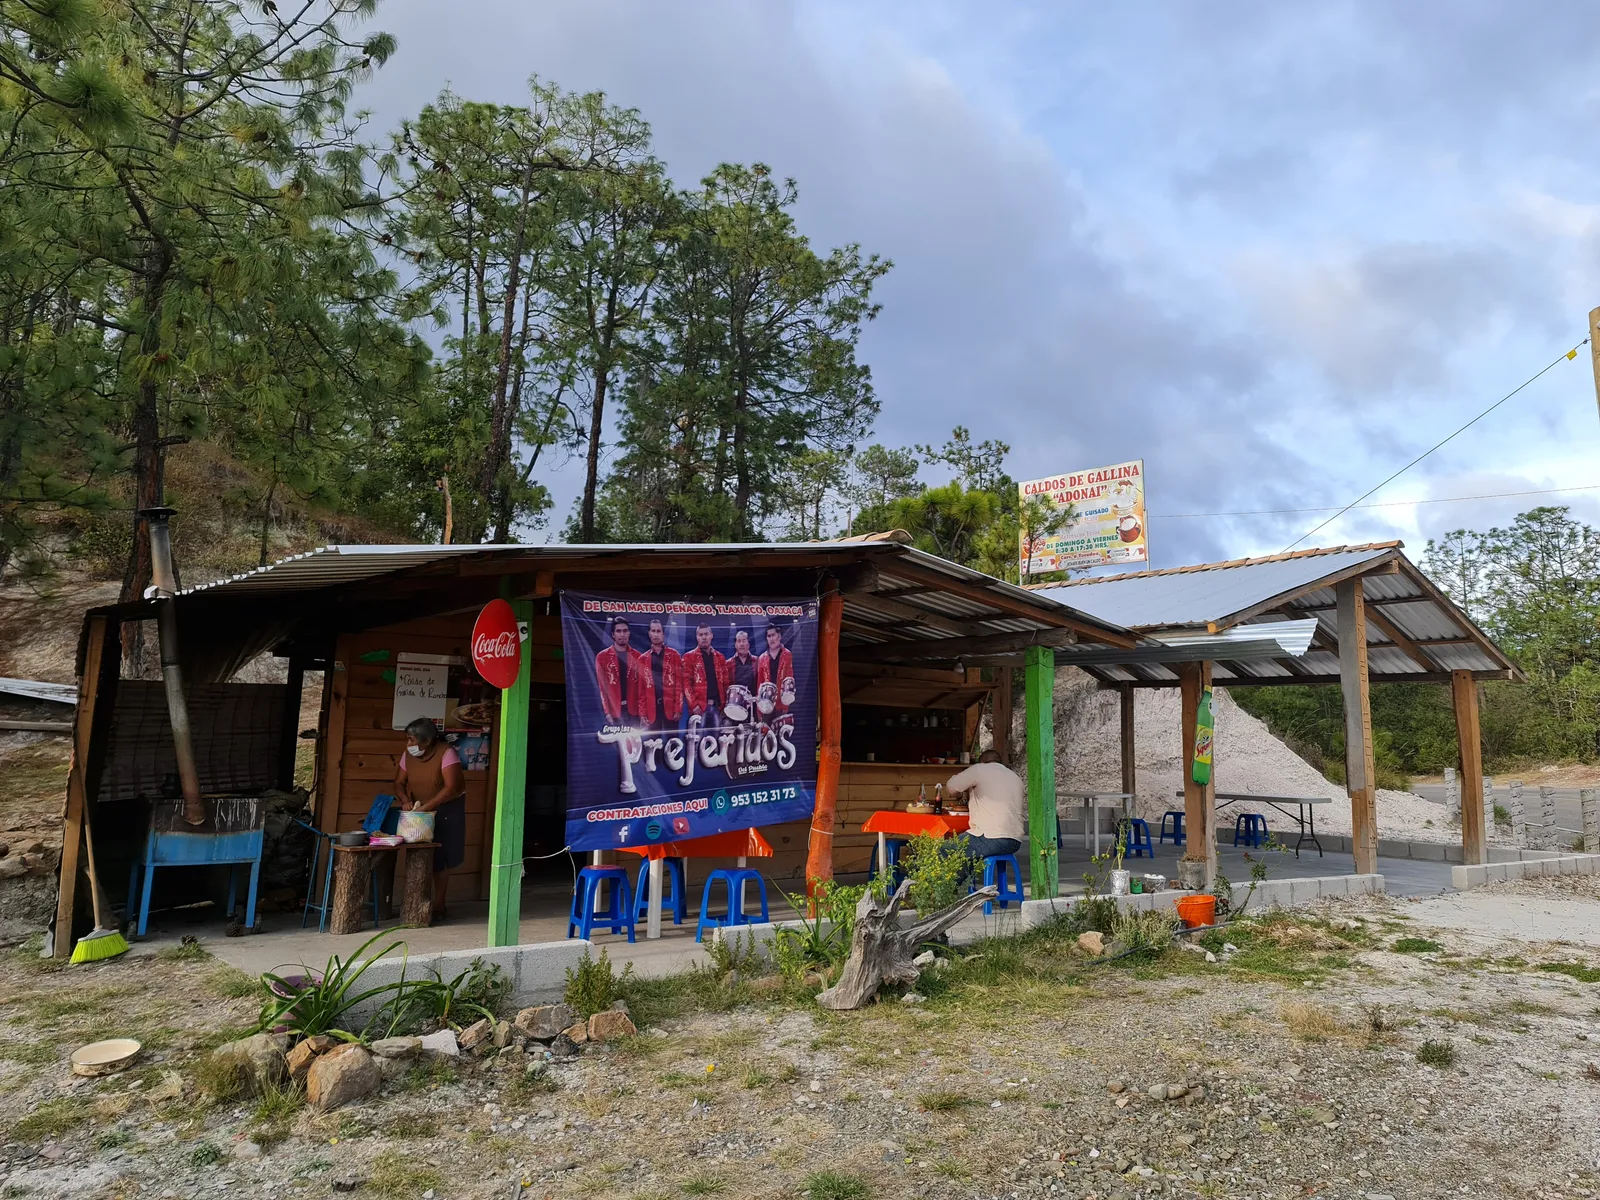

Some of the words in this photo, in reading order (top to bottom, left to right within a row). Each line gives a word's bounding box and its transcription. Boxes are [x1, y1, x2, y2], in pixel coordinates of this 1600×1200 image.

[1024, 478, 1066, 495] CALDOS
[1069, 474, 1084, 488] DE
[1087, 464, 1140, 484] GALLINA
[1084, 507, 1109, 516] GUISADO
[1055, 539, 1085, 547] DOMINGO
[583, 601, 601, 612] DE
[602, 601, 625, 613] SAN
[626, 602, 664, 614] MATEO
[665, 601, 716, 616] PEÑASCO,
[715, 604, 766, 617] TLAXIACO,
[766, 605, 803, 616] OAXACA
[474, 631, 516, 662] Coca-Cola
[1196, 740, 1212, 758] Squ
[748, 764, 768, 773] Pueblo
[731, 794, 750, 807] 953
[751, 791, 768, 804] 152
[770, 789, 780, 801] 31
[782, 787, 796, 799] 73
[587, 803, 683, 822] CONTRATACIONES
[685, 798, 708, 812] AQUI
